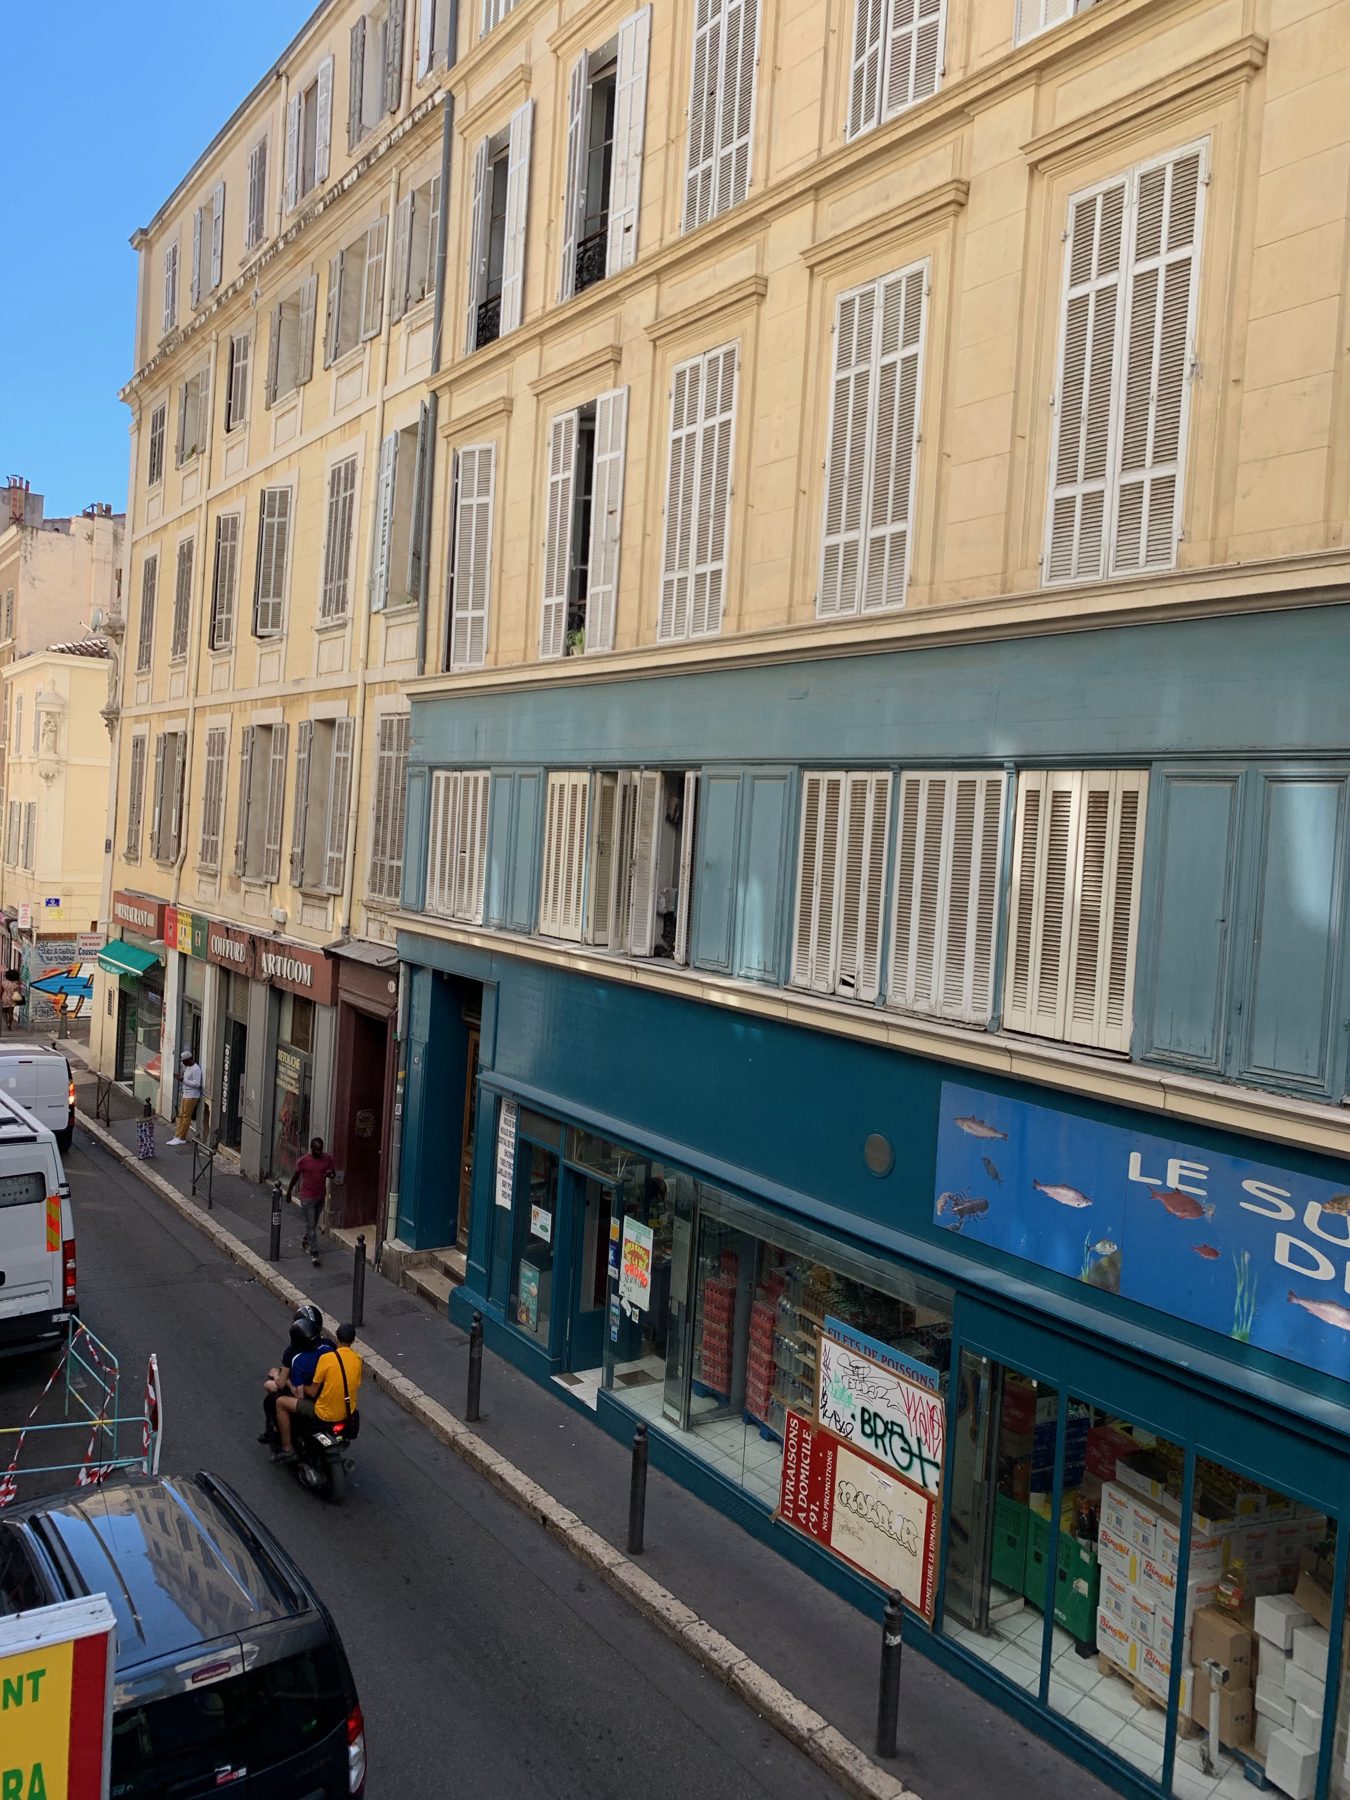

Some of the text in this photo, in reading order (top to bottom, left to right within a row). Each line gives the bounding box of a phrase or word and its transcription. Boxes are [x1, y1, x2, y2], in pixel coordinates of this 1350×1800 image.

[211, 934, 245, 963] COIFFURE
[261, 952, 312, 987] ARTICOM
[1128, 1152, 1209, 1196] LE
[624, 1262, 649, 1291] PROMO
[783, 1417, 800, 1518] LIVRAISONS
[798, 1429, 812, 1524] A DOMICILE
[823, 1449, 834, 1510] PROMOTIONS
[2, 1669, 47, 1710] NT
[2, 1763, 47, 1800] RA
